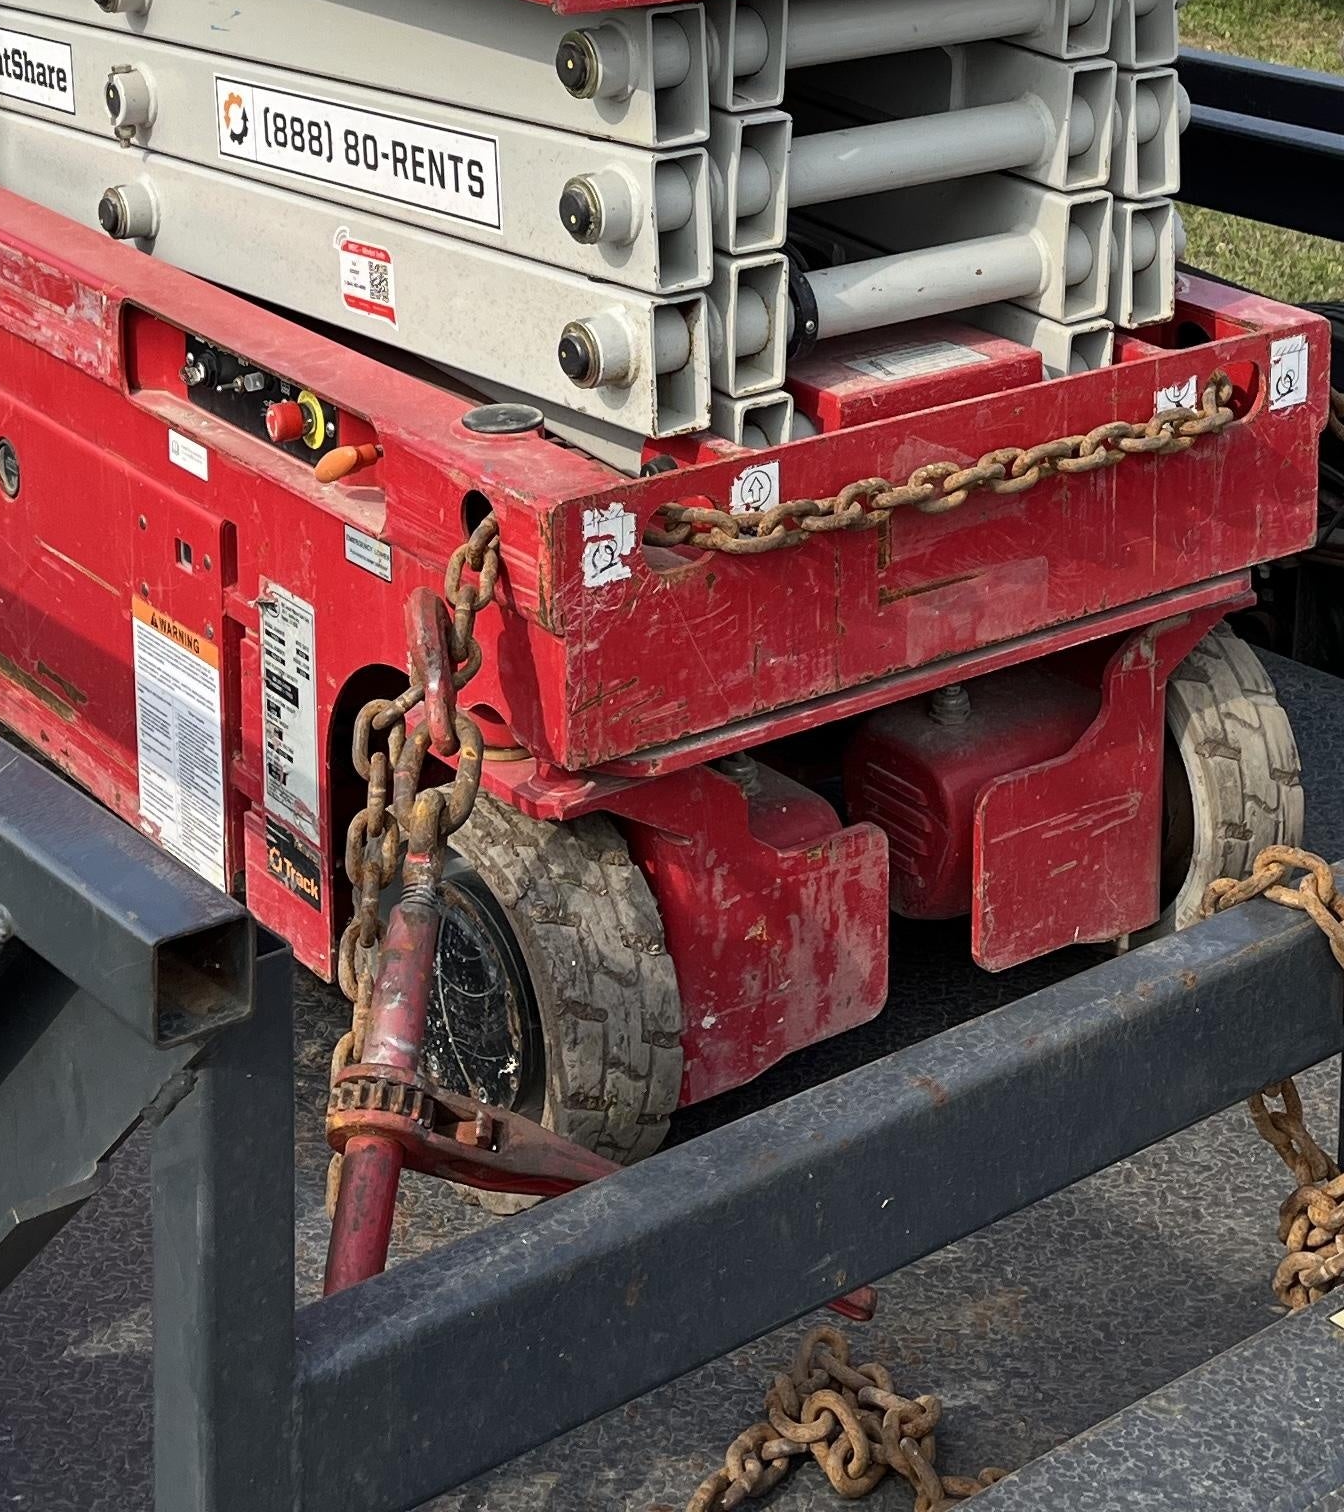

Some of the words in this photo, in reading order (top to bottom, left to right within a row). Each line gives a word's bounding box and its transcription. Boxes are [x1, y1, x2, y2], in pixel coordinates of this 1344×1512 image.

[263, 106, 334, 164] (888)
[343, 128, 485, 200] 80-RENTS
[159, 617, 200, 654] WARNING
[283, 857, 319, 901] Track
